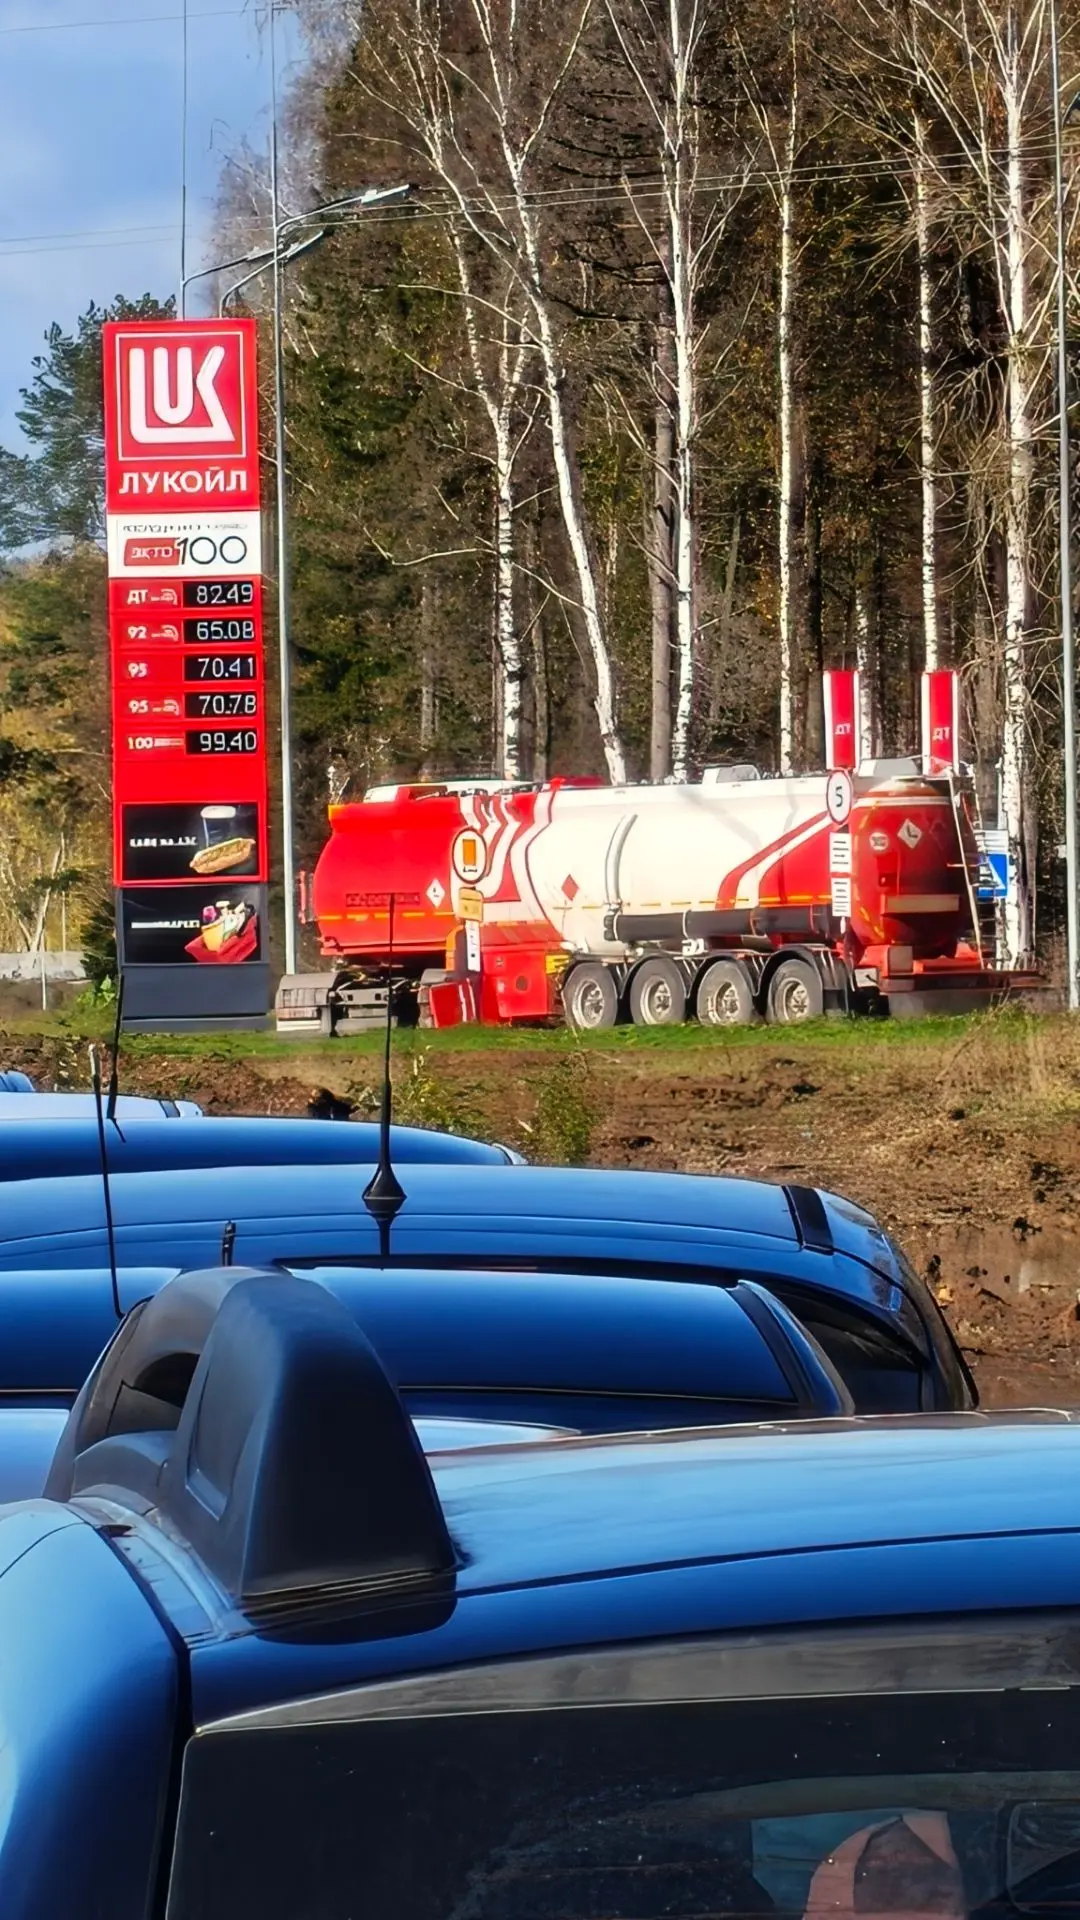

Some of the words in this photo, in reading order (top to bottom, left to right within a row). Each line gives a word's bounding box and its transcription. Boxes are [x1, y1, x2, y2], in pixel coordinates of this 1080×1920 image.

[119, 466, 248, 494] ЛУКОЙЛ
[175, 535, 248, 565] 100
[127, 625, 147, 640] 92
[196, 620, 255, 640] 65.08
[128, 662, 148, 679] 95
[197, 657, 254, 678] 70.41
[128, 699, 149, 714] 95
[127, 736, 154, 750] 100
[199, 731, 257, 752] 99.40
